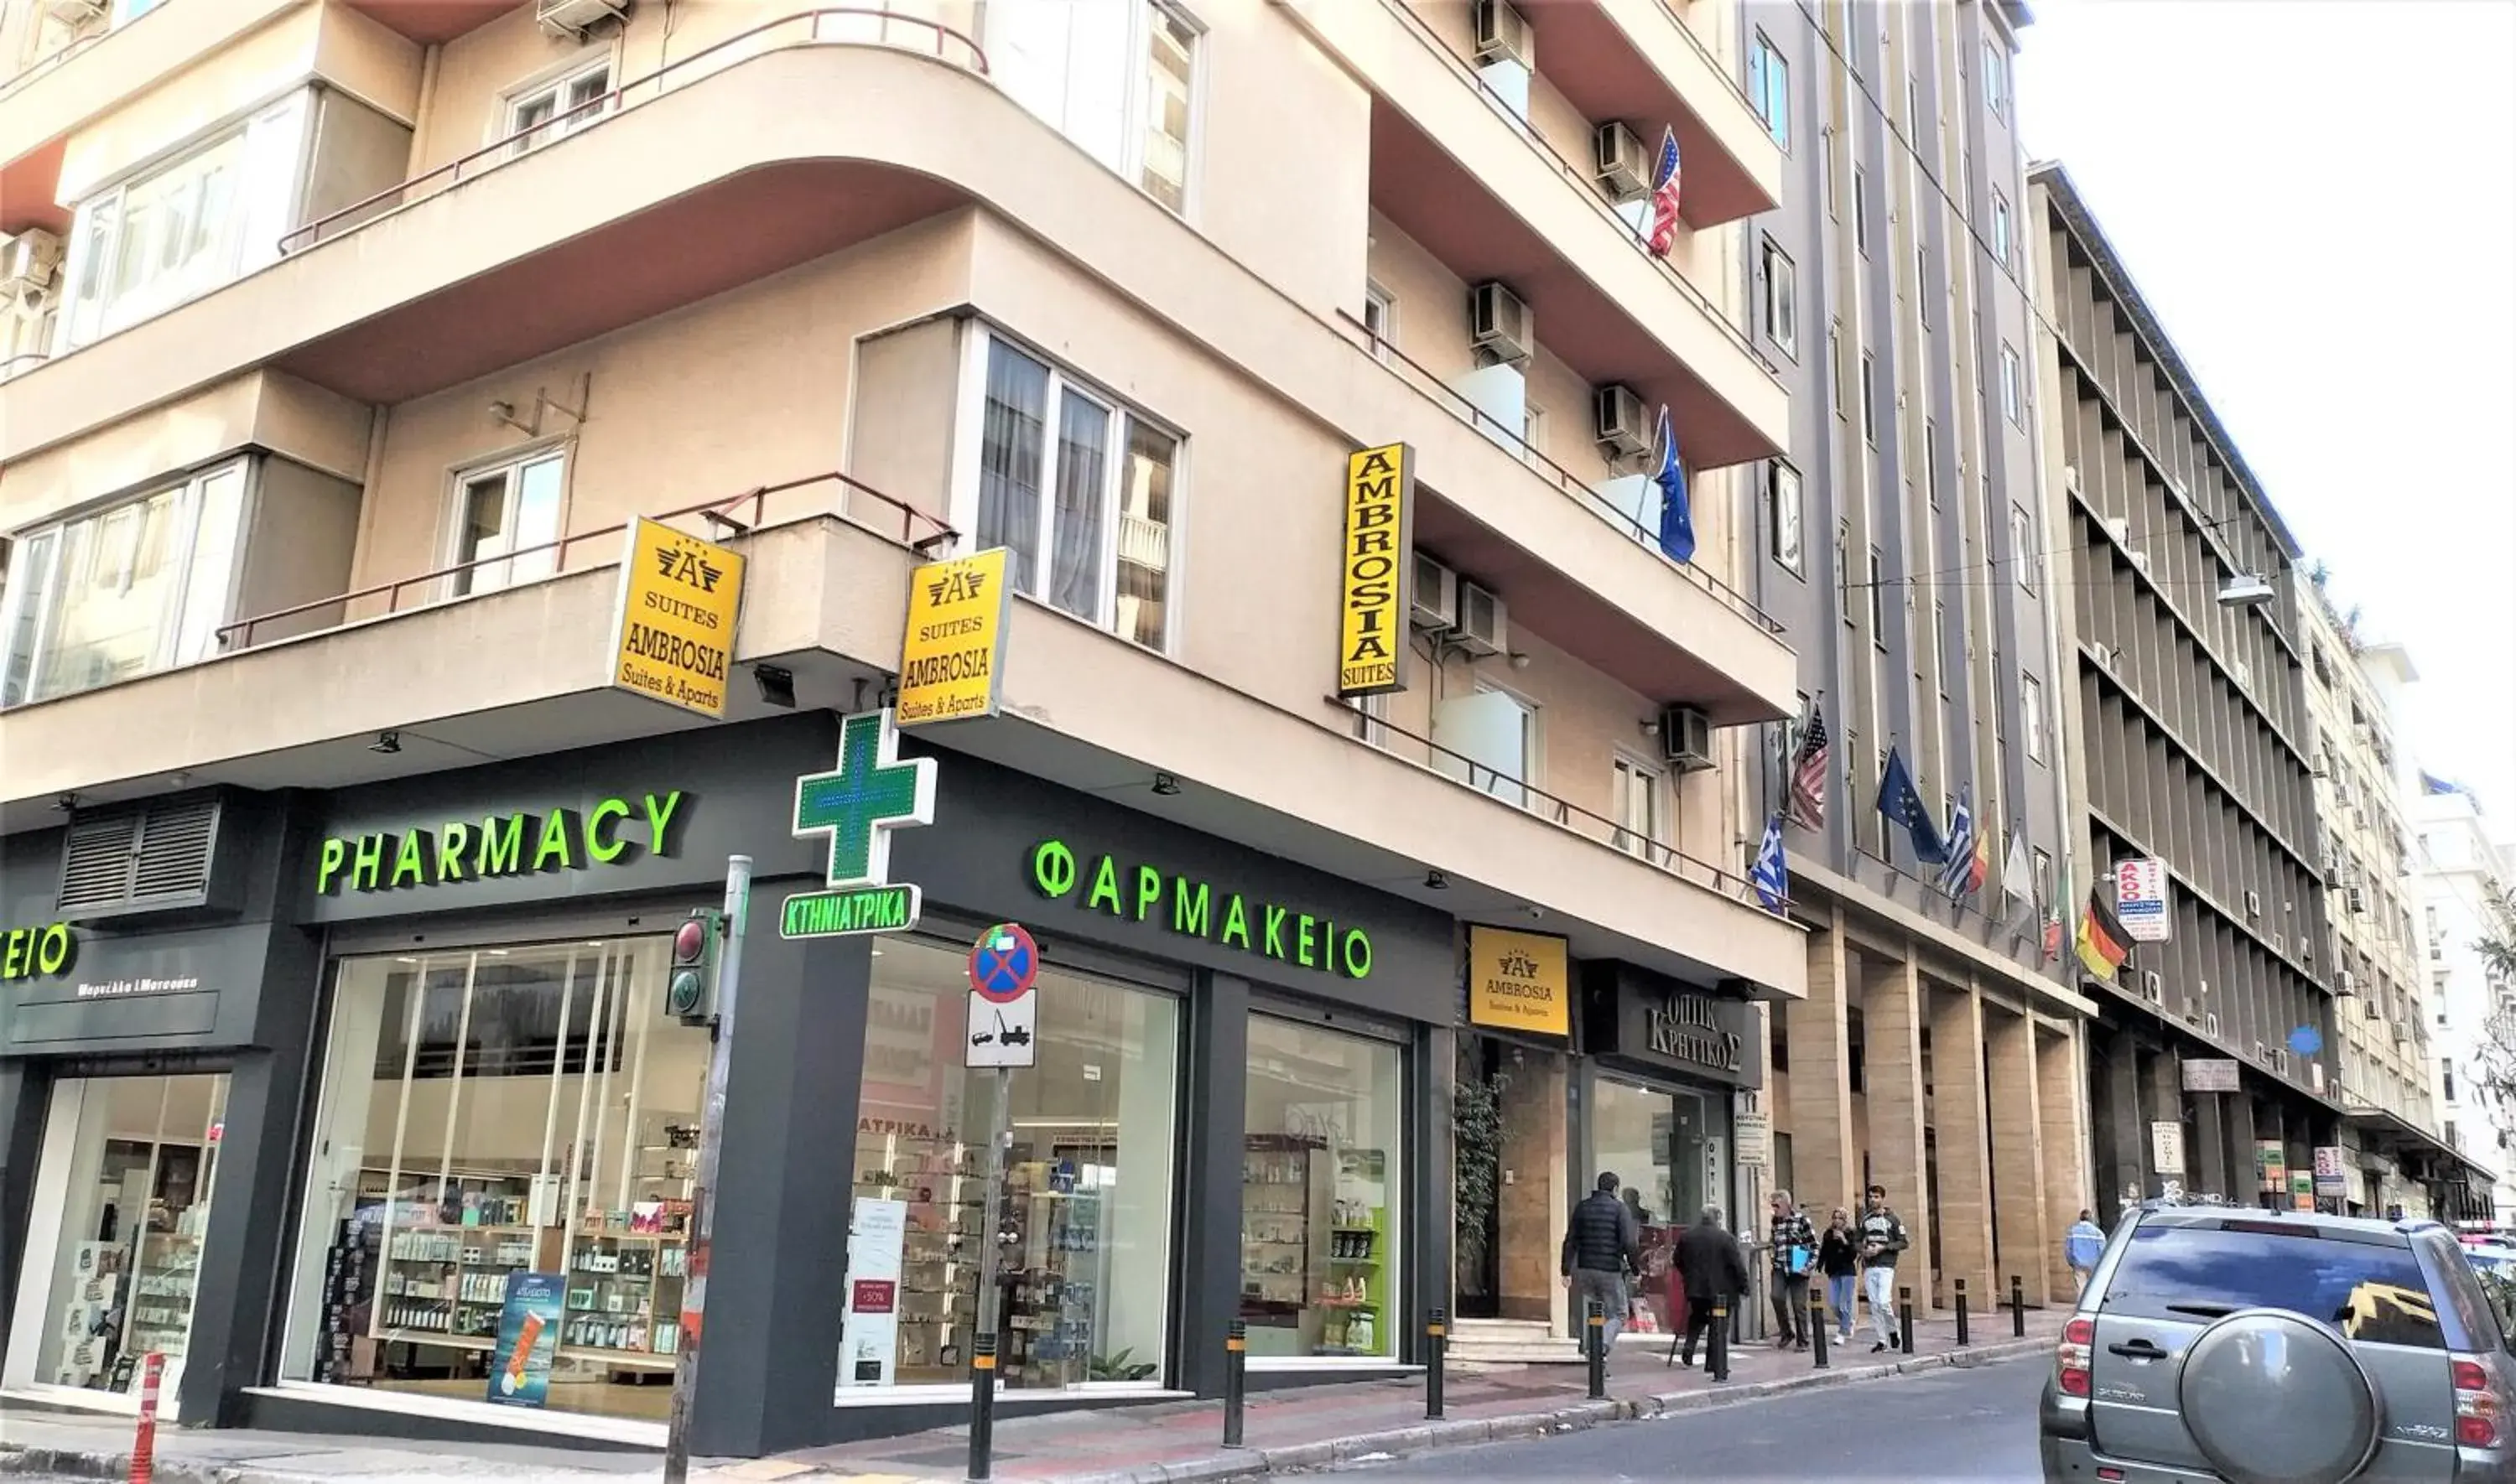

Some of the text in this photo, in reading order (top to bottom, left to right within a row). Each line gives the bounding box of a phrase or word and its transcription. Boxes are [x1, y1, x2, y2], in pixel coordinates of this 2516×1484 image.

[1349, 452, 1395, 661] AMBROSIA
[645, 591, 719, 630] SUITES
[920, 616, 983, 642] SUITES
[626, 623, 724, 682] AMBROSIA
[904, 647, 989, 689] AMBROSIA
[1343, 662, 1394, 686] SUITES
[621, 662, 719, 708] Suites & Aparts
[901, 694, 985, 719] Suites & Aparts
[317, 791, 681, 895] PHARMACY
[786, 890, 905, 934] ΚΤΗΝΙΑΤΡΙΚΑ
[1036, 840, 1373, 978] ΦΑΡΜΑΚΕΙΟ
[0, 921, 68, 979] ΕΙΟ
[1486, 979, 1552, 1001] AMBROSIA
